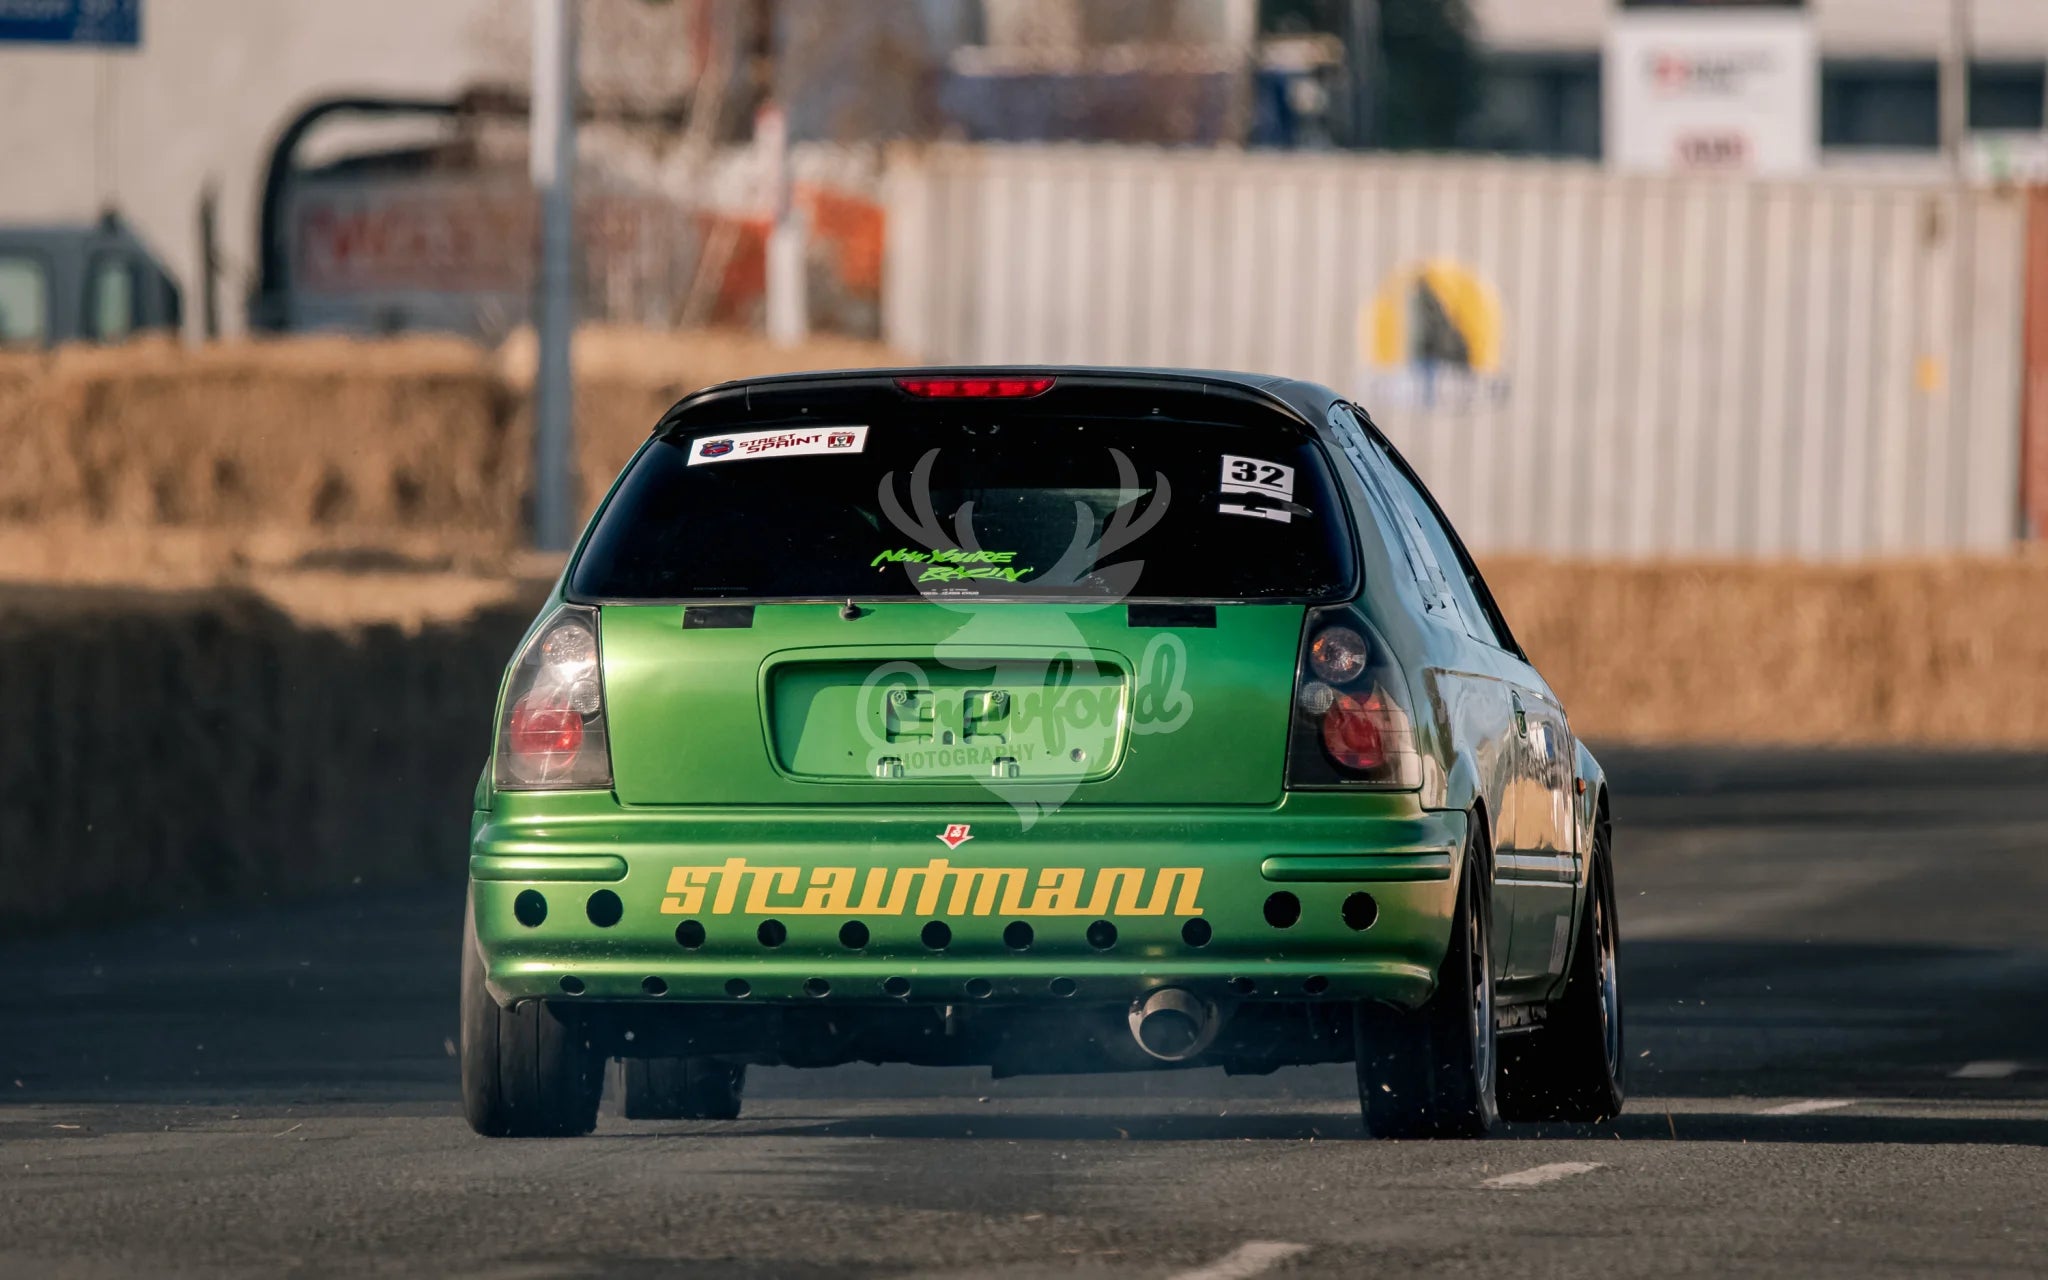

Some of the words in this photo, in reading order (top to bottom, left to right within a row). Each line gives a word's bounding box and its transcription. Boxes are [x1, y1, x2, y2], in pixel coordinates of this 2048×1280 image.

[739, 434, 796, 449] STREET
[748, 434, 823, 453] SPRINT
[1231, 460, 1285, 488] 32
[660, 859, 1204, 916] strautmann
